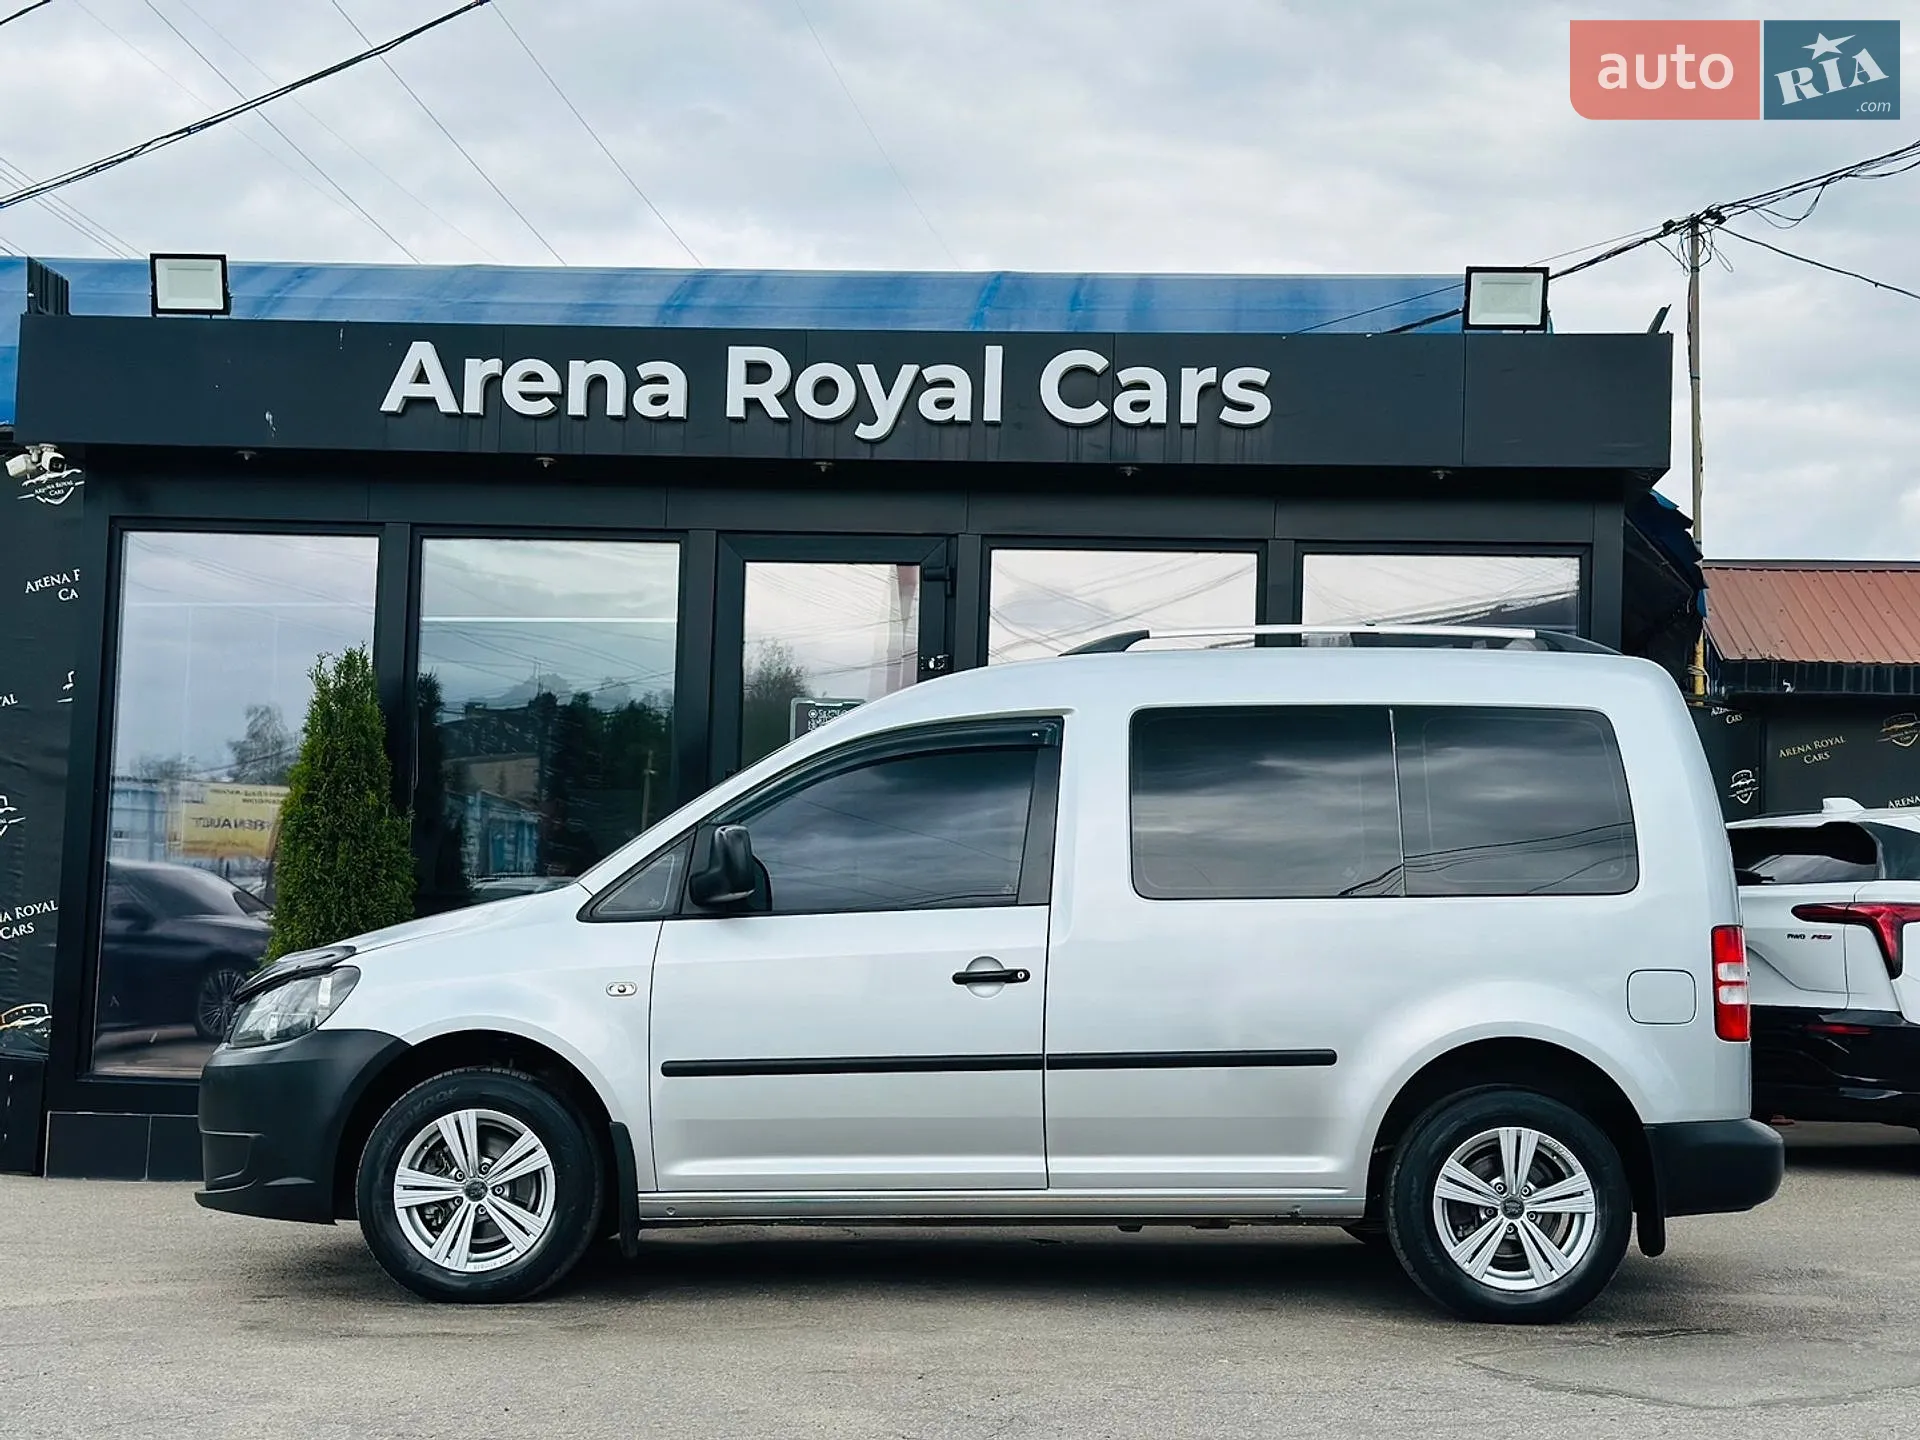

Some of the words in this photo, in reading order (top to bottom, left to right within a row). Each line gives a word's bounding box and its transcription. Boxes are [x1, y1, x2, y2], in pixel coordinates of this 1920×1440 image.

[380, 341, 688, 420] Arena
[726, 346, 1004, 440] Royal
[1040, 350, 1272, 425] Cars
[25, 573, 71, 593] ARENA
[1779, 744, 1812, 758] ARENA
[1813, 735, 1846, 749] ROYAL
[1803, 750, 1831, 764] CARS
[14, 900, 59, 920] ROYAL
[0, 921, 35, 940] CARS
